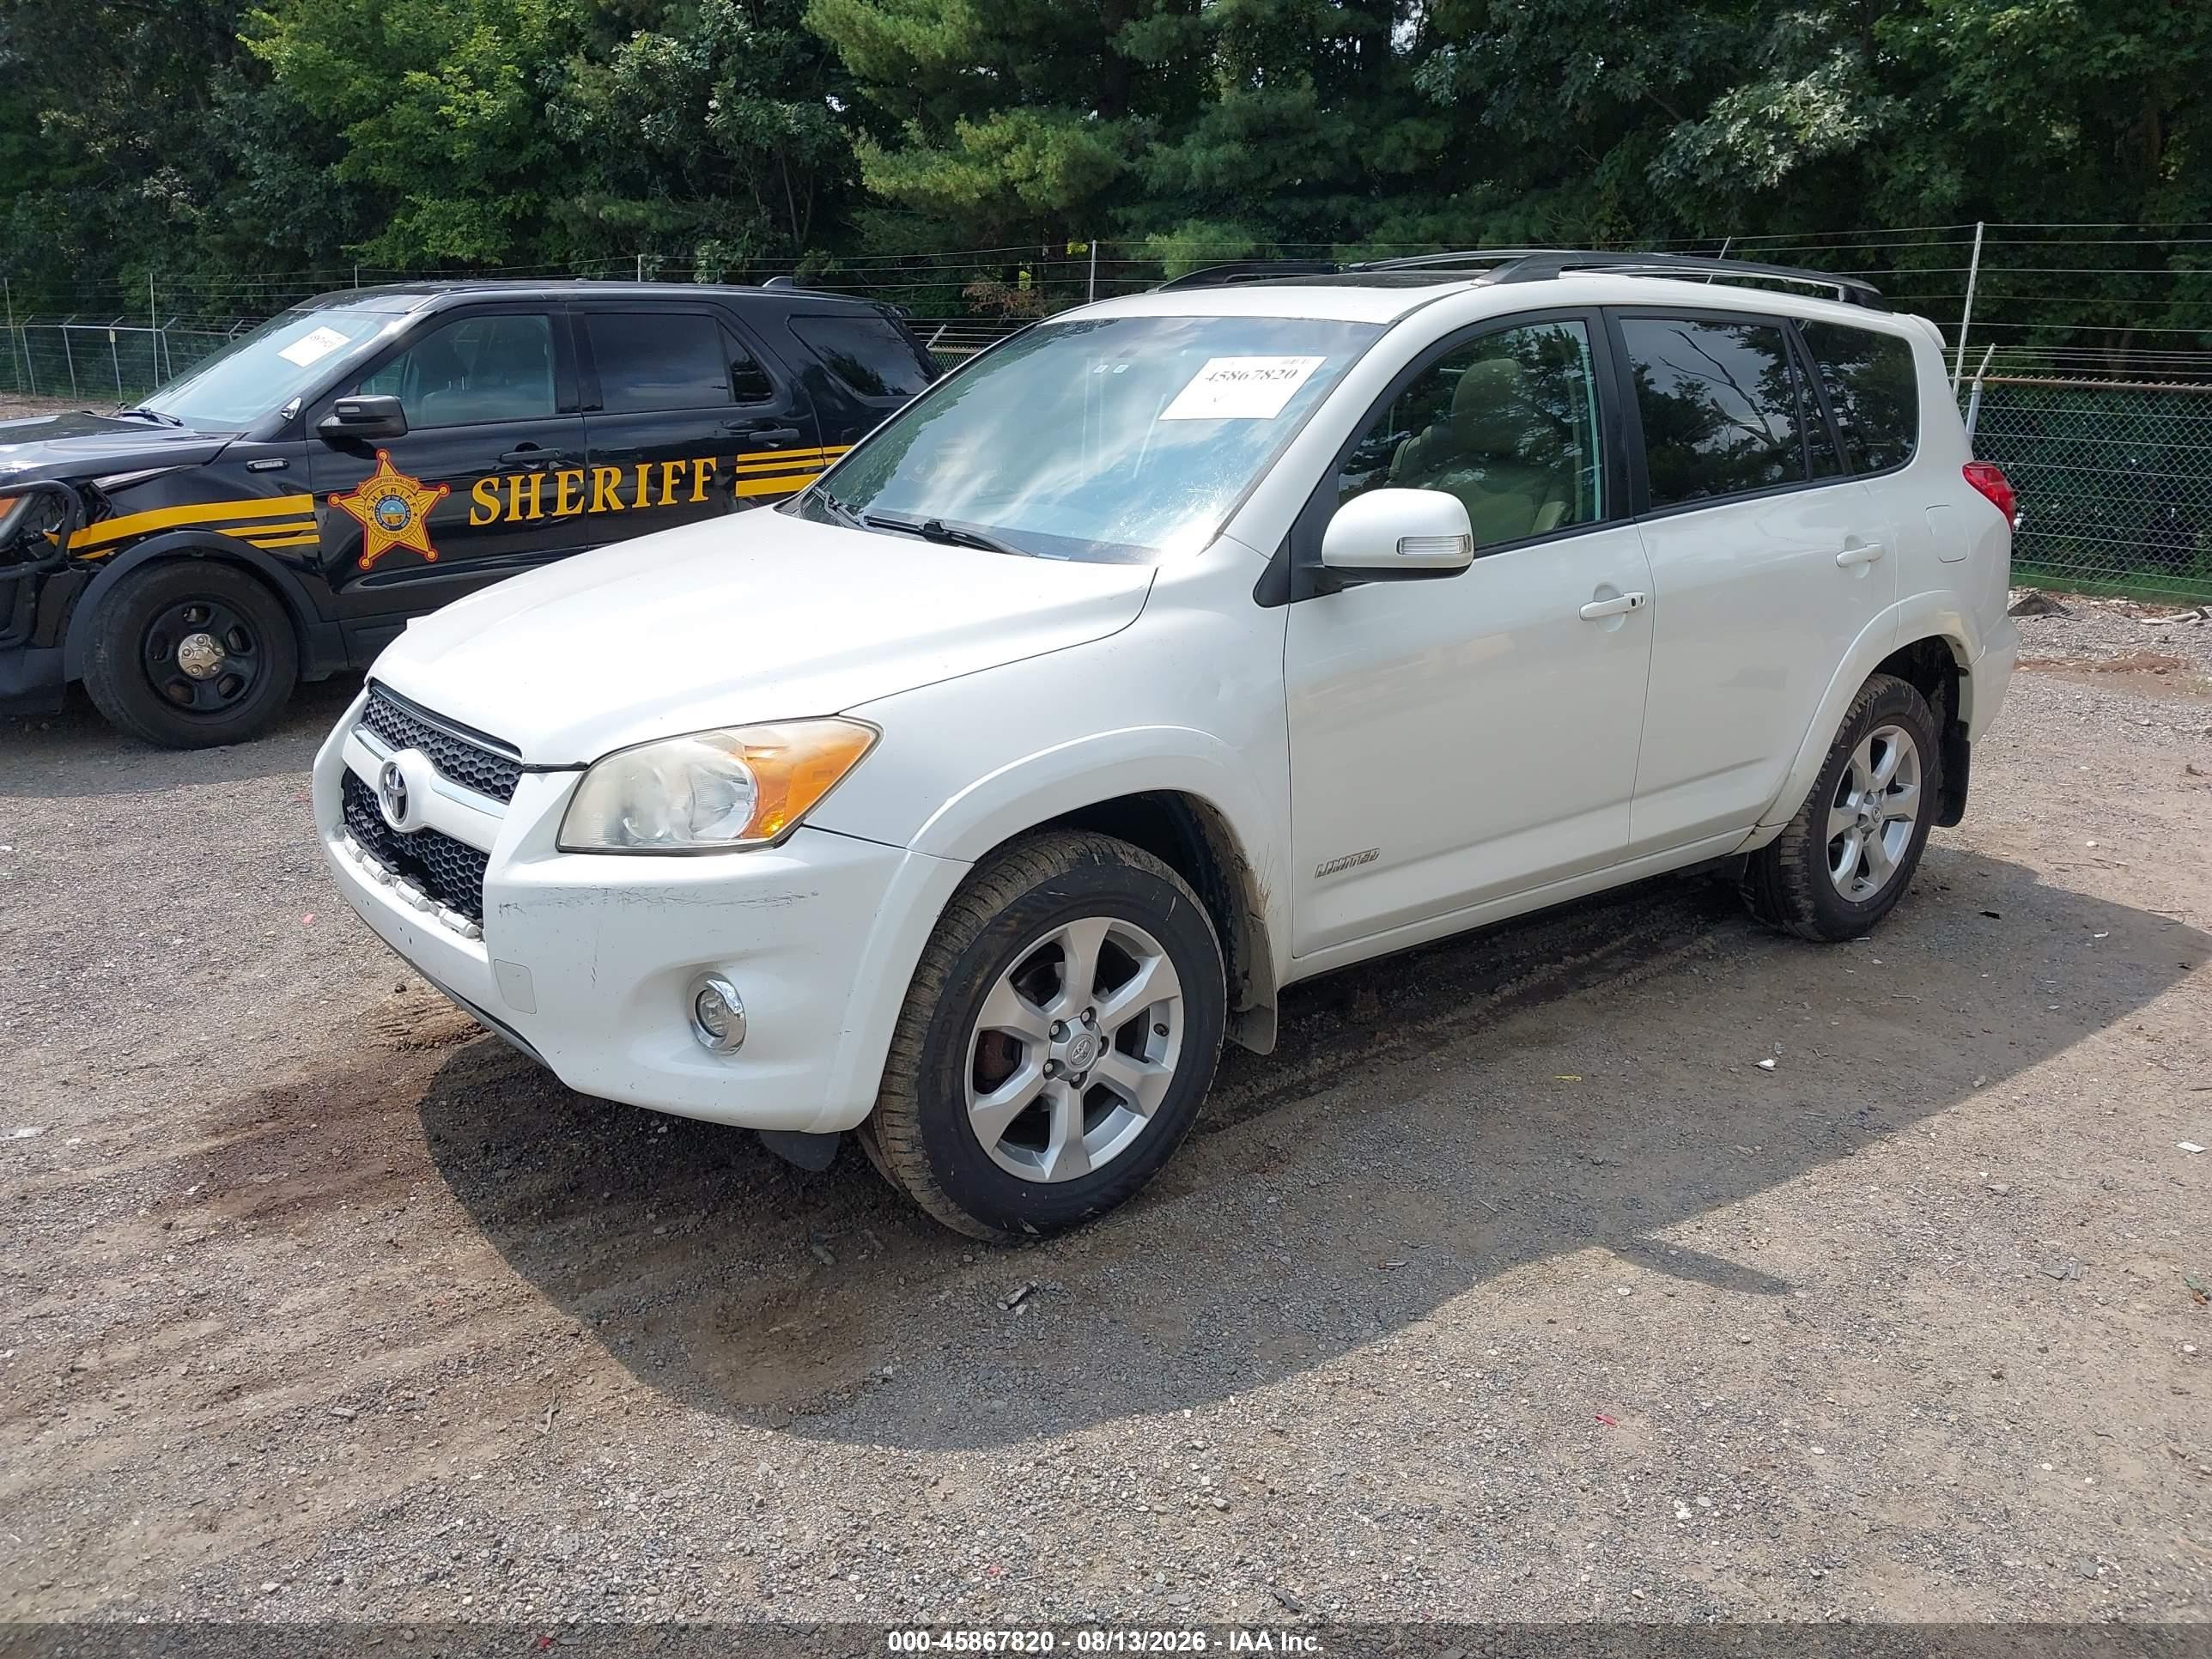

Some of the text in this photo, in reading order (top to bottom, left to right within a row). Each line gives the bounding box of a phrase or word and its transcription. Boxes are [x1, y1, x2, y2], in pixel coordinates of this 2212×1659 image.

[1205, 368, 1298, 382] 45867820
[362, 477, 392, 496] CHRISTOPHER
[469, 457, 718, 526] SHERIFF
[367, 487, 417, 512] SHERIFF
[1315, 848, 1380, 878] LIMITED
